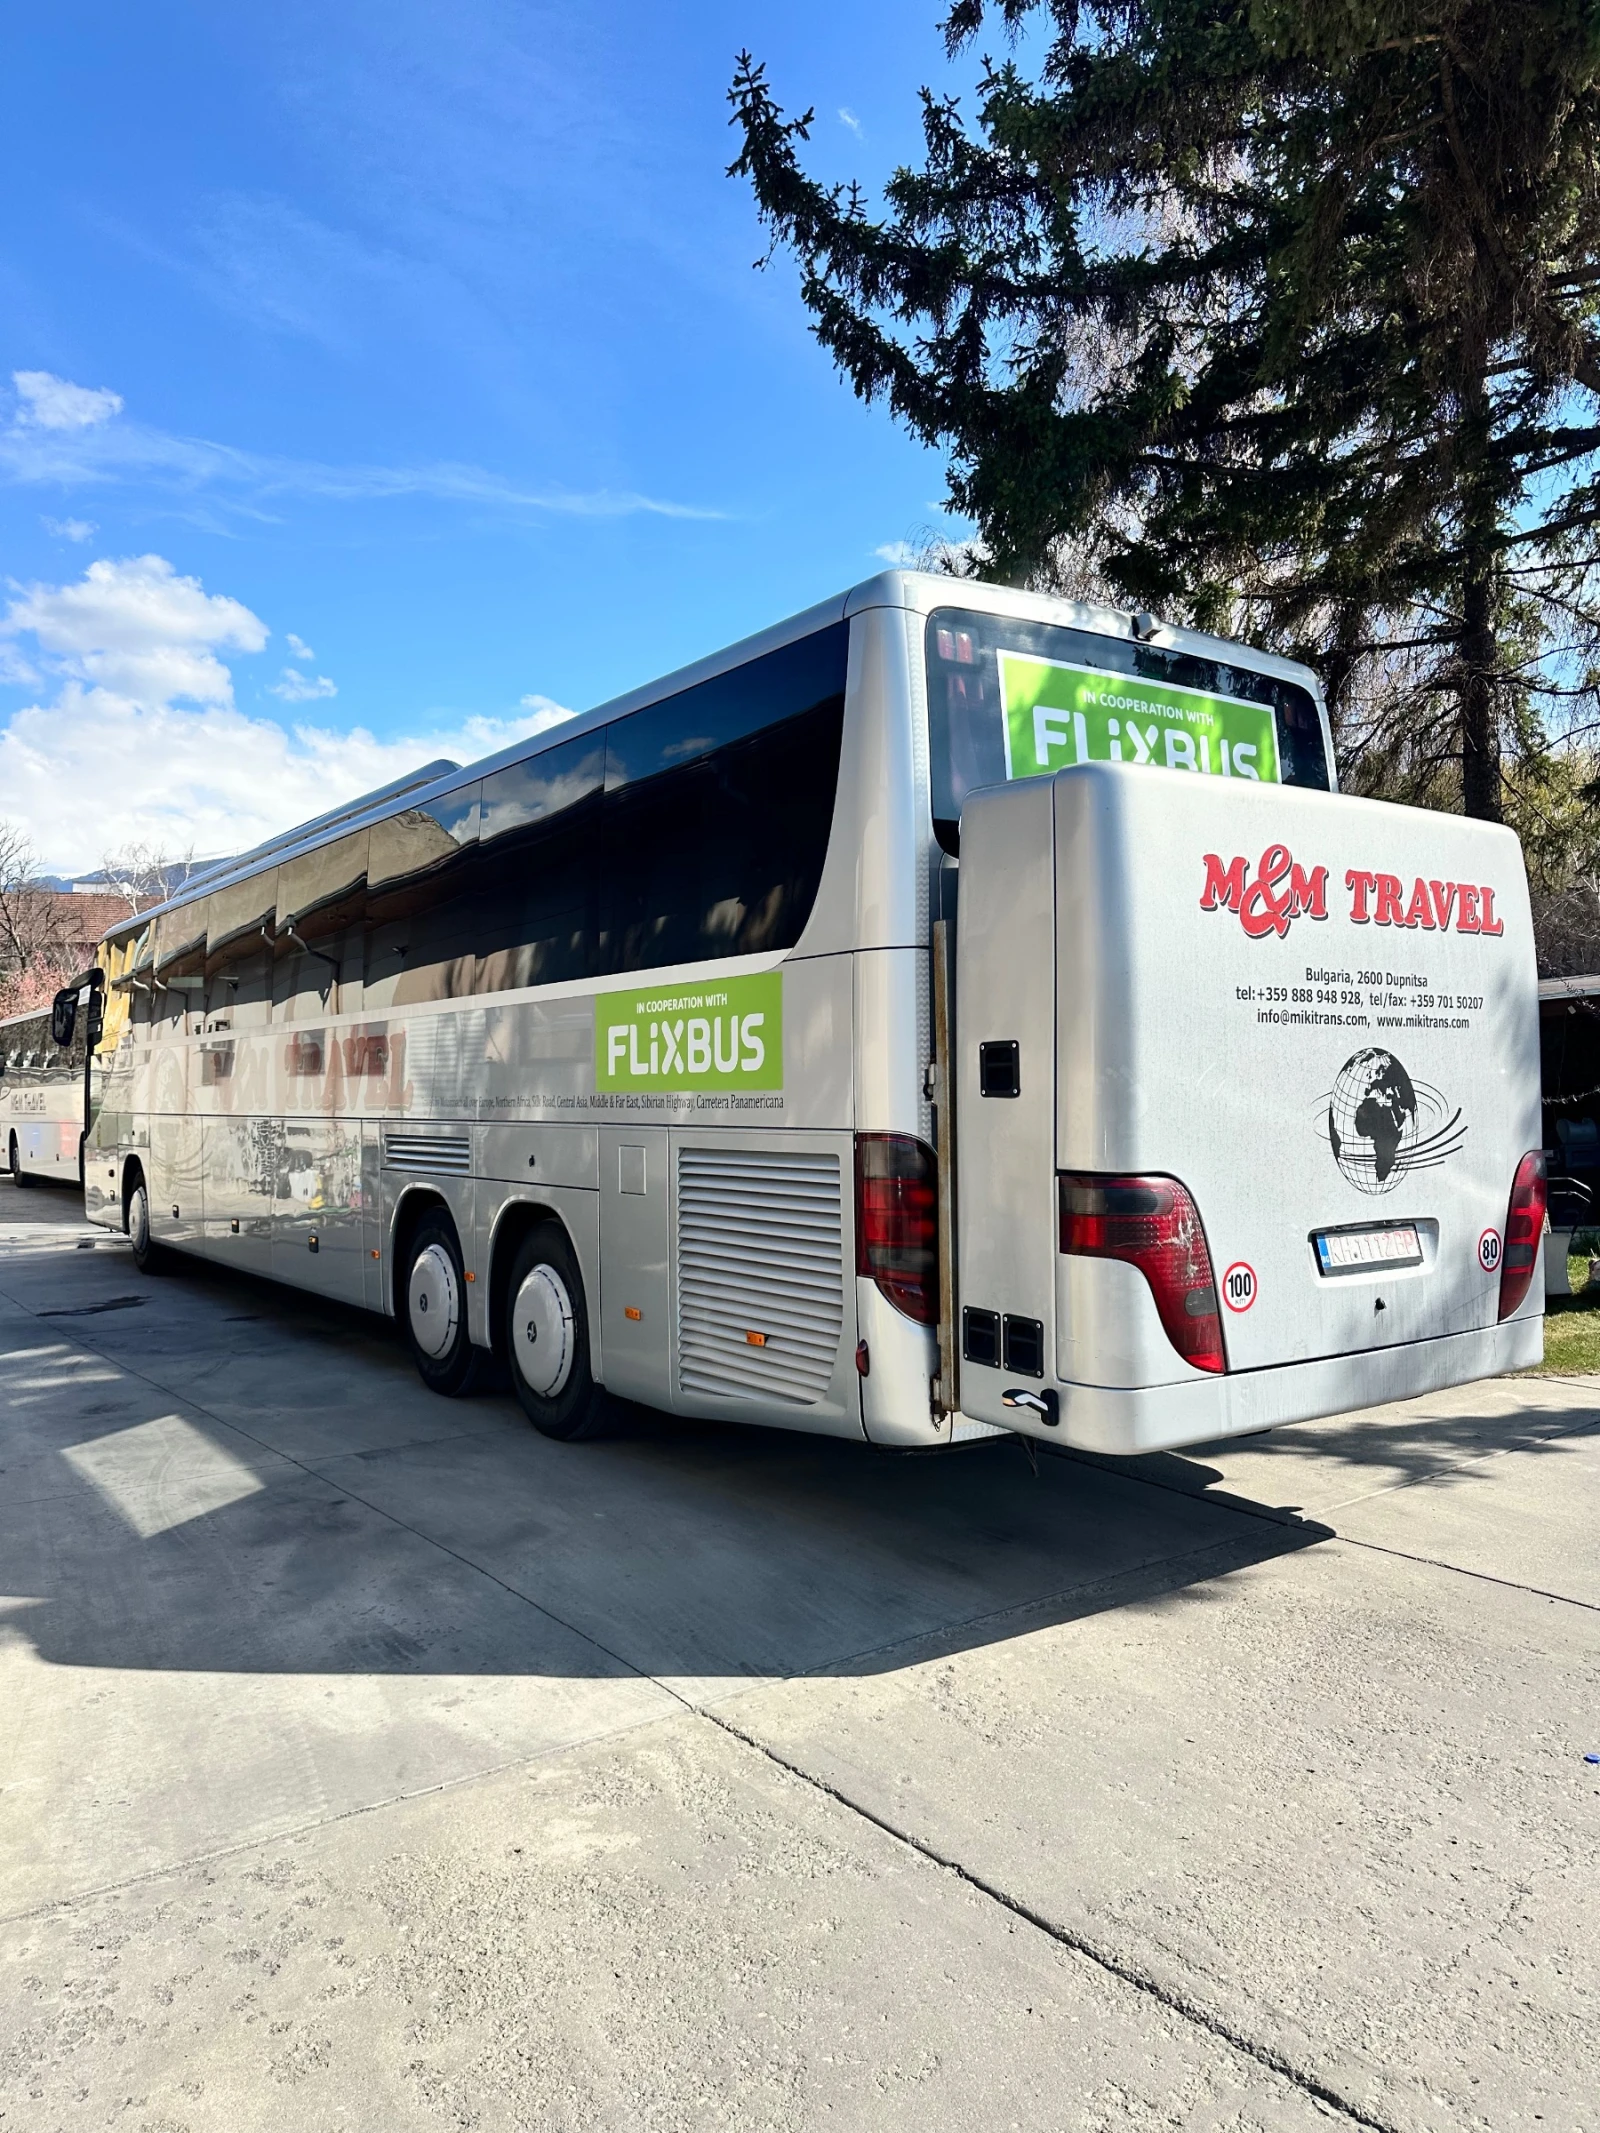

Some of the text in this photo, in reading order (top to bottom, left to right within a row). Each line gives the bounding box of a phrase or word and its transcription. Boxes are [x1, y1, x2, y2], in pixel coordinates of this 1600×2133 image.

[1083, 690, 1214, 727] IN COOPERATION WITH
[1200, 844, 1504, 939] M&M TRAVEL
[1305, 967, 1428, 989] Bulgaria, 2600 Dupnitsa
[636, 993, 728, 1014] IN COOPERATION WITH
[1291, 988, 1313, 1003] 888
[1316, 989, 1338, 1004] 948
[1340, 991, 1364, 1008] 928,
[1369, 992, 1407, 1008] tel/fax:
[1410, 994, 1435, 1008] +359
[1437, 995, 1454, 1009] 701
[1456, 996, 1484, 1009] 50207
[1257, 1008, 1470, 1029] info@mikitrans.com, www.mikitrans.com
[284, 1032, 414, 1111] TRAVEL
[557, 1095, 575, 1108] Central
[590, 1095, 608, 1109] Middle
[616, 1095, 625, 1108] Far
[626, 1095, 641, 1110] East,
[666, 1095, 696, 1113] Highway,
[697, 1095, 729, 1109] Carretera
[730, 1094, 784, 1109] Panamericana
[1483, 1238, 1497, 1260] 80
[1228, 1272, 1251, 1298] 100
